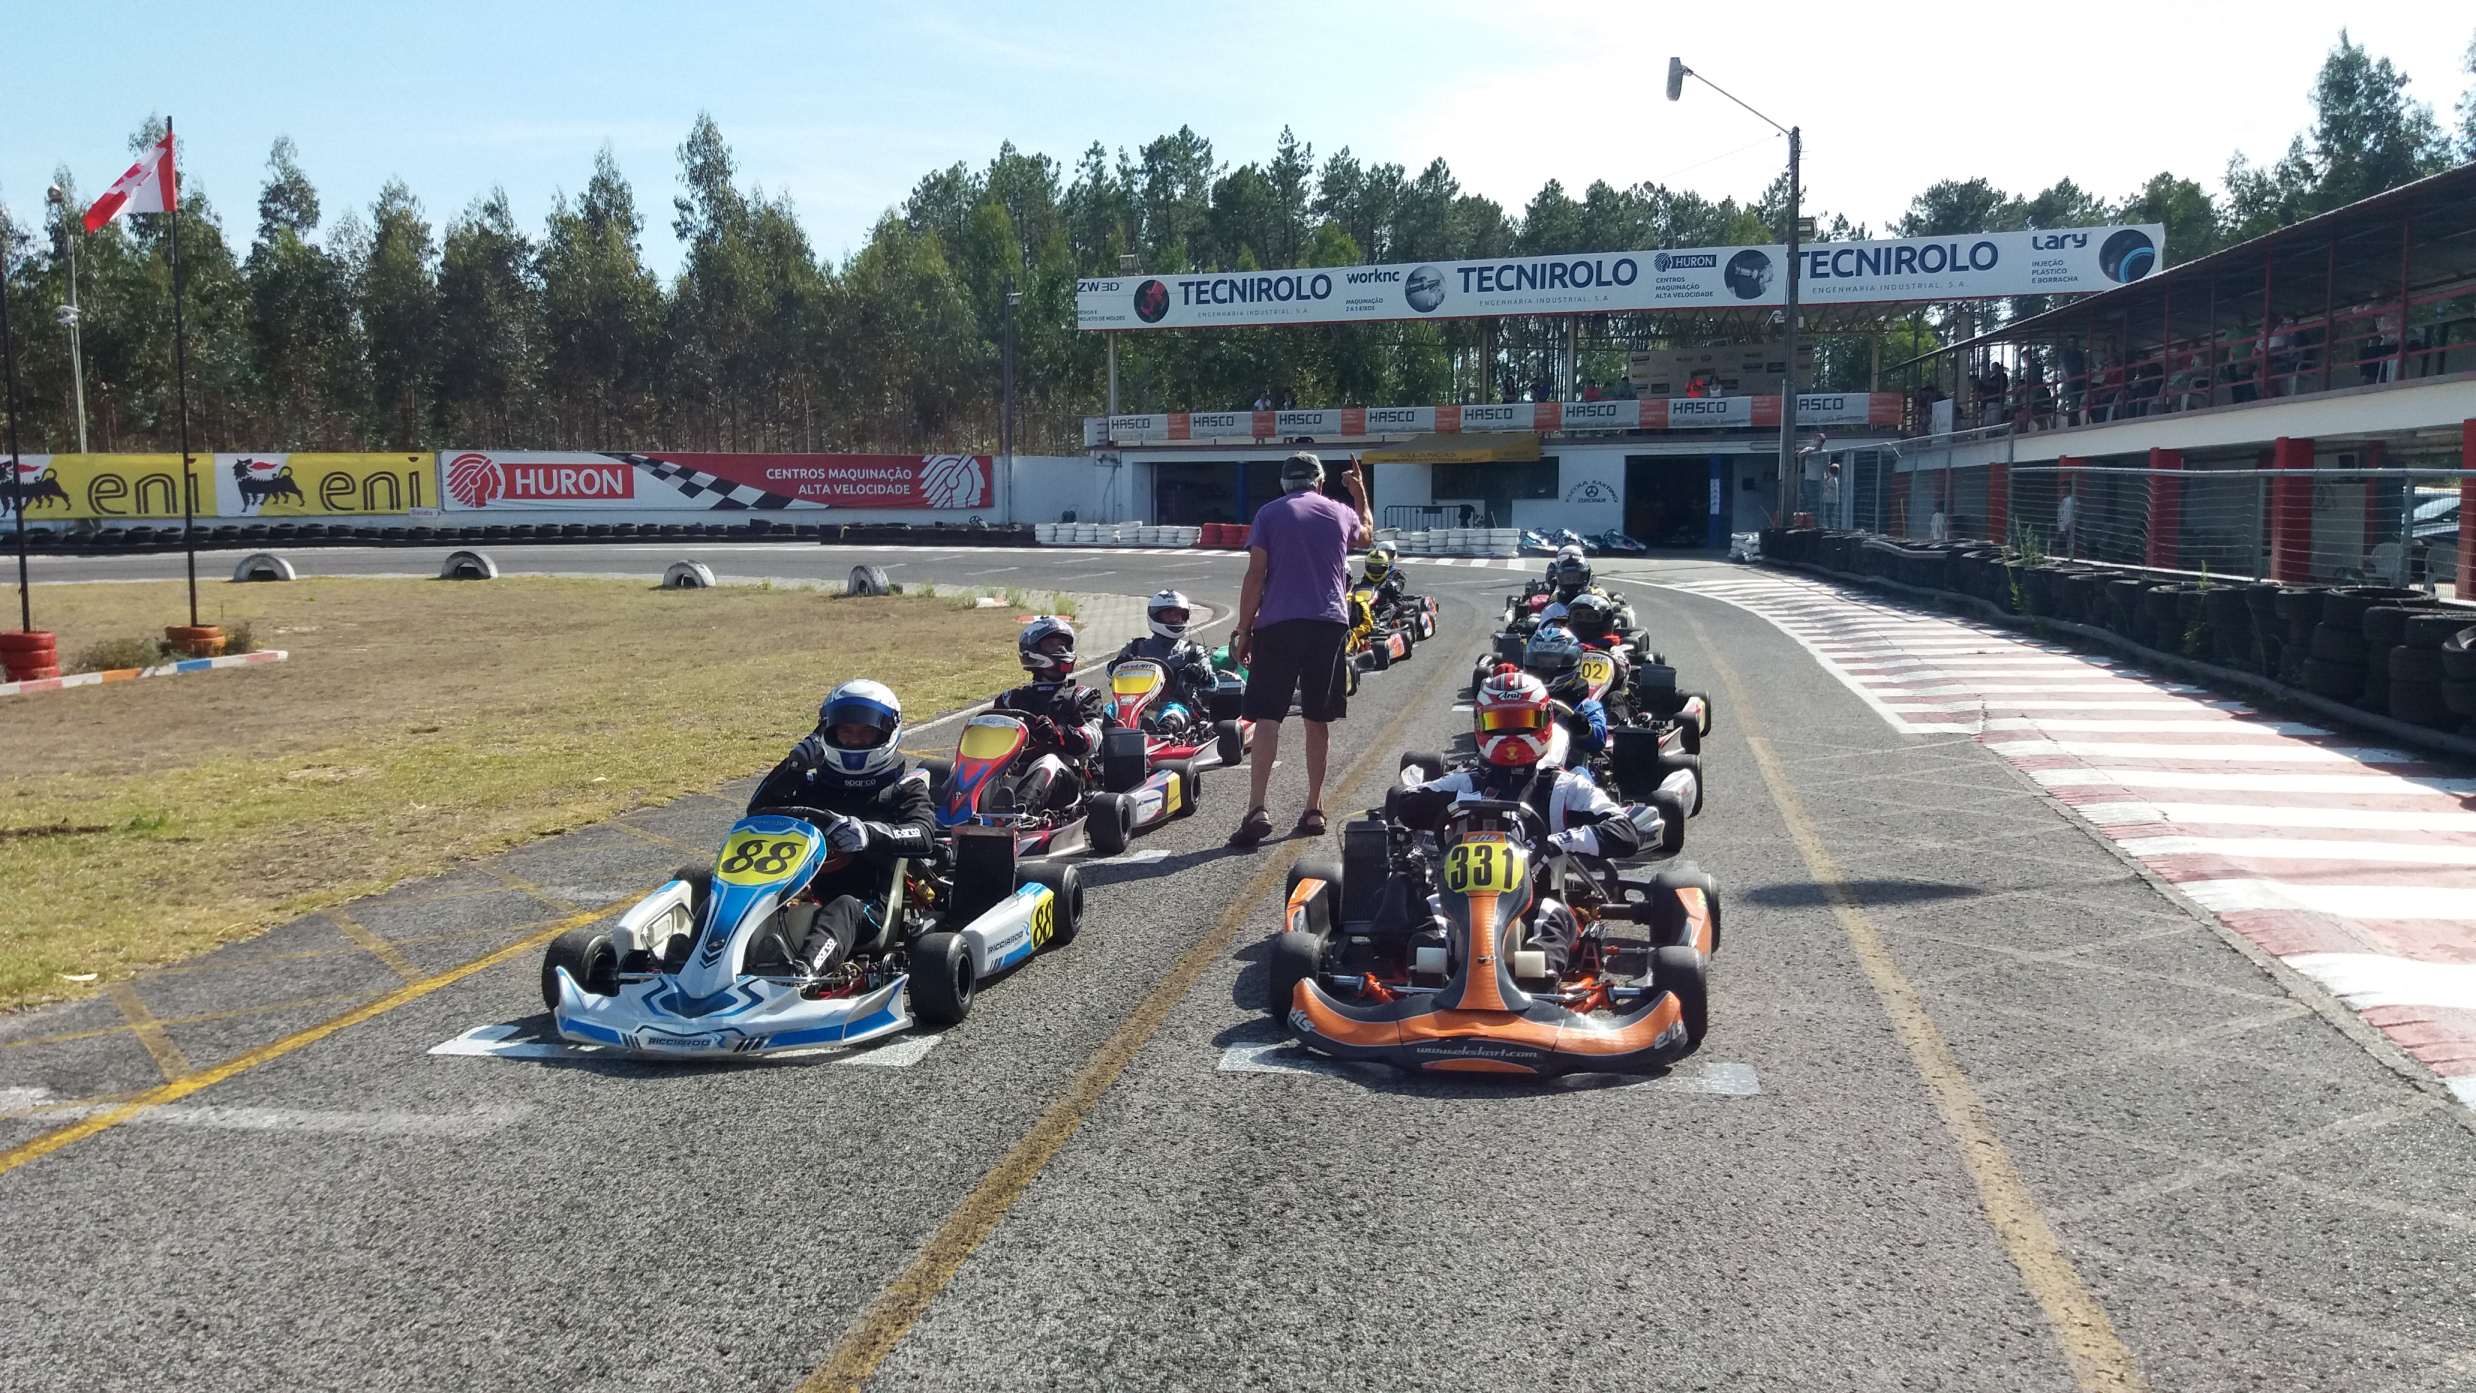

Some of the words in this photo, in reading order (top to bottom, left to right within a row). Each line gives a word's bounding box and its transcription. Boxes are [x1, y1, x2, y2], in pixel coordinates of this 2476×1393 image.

[1675, 256, 1713, 267] HURON
[2031, 258, 2064, 268] INJEÇÃO
[1346, 269, 1400, 284] worknc
[1457, 258, 1638, 293] TECNIROLO
[1178, 273, 1332, 305] TECNIROLO
[1656, 283, 1699, 291] MAQUINAÇÃO
[1812, 285, 1876, 295] ENGENHARIA
[1566, 404, 1616, 417] HASCO
[1673, 401, 1727, 414] HASCO
[1799, 398, 1843, 411] ASCO
[1279, 414, 1322, 425] HASCO
[1369, 411, 1414, 423] HASCO
[1464, 408, 1512, 420] HASCO
[1111, 418, 1150, 430] HASCO
[1194, 416, 1234, 427] HASCO
[767, 468, 825, 481] CENTROS
[828, 467, 912, 483] MAQUINAÇÃO
[319, 457, 421, 511] eni
[514, 469, 624, 496] HURON
[799, 485, 830, 496] ALTA
[832, 484, 911, 496] VELOCIDADE
[1582, 662, 1603, 680] 02
[1498, 691, 1521, 699] Arai
[721, 840, 804, 874] 88
[1451, 845, 1514, 890] 331
[1033, 899, 1053, 948] 88
[814, 937, 837, 970] sparco
[647, 1037, 711, 1046] RICCIARDO
